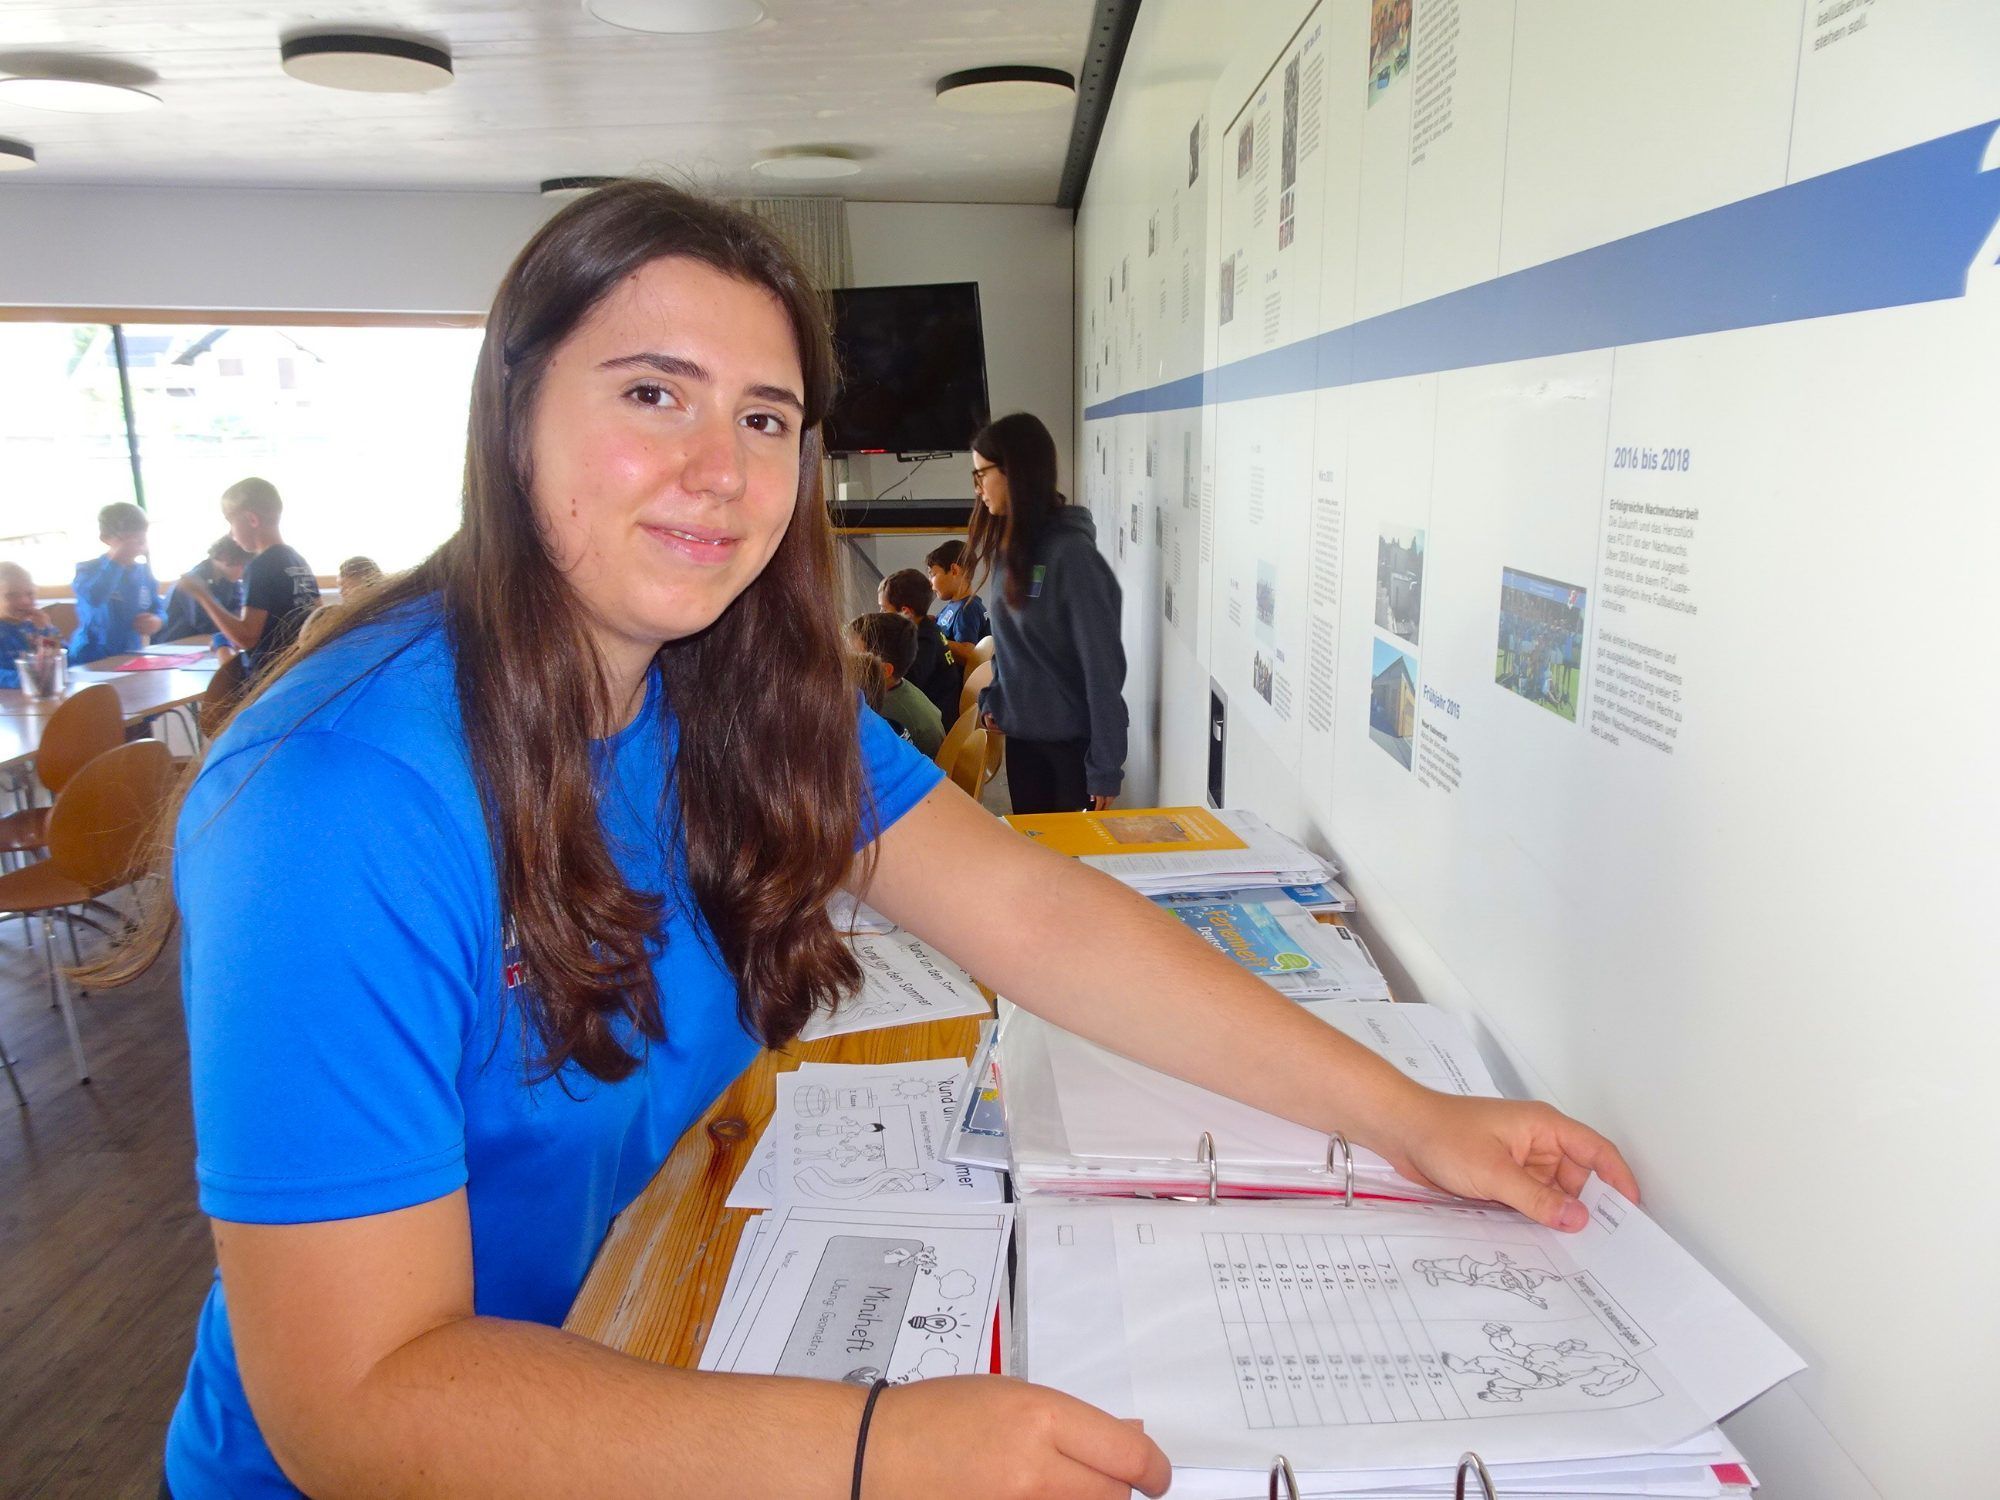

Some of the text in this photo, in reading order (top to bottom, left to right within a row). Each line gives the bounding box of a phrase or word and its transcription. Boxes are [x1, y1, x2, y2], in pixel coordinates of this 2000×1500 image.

[1614, 447, 1690, 472] 2016 bis 2018
[1610, 499, 1699, 520] Erfolgreiche Nachwuchsarbeit
[1423, 684, 1460, 720] Frühjahr 2015
[1204, 910, 1269, 967] Ferienheft
[909, 941, 928, 959] Rund
[928, 968, 944, 981] den
[876, 959, 890, 971] um
[886, 968, 903, 982] den
[900, 982, 933, 1006] Sommer
[938, 1079, 960, 1104] Rund
[806, 1311, 836, 1357] Geometrie
[846, 1286, 893, 1354] Miniheft
